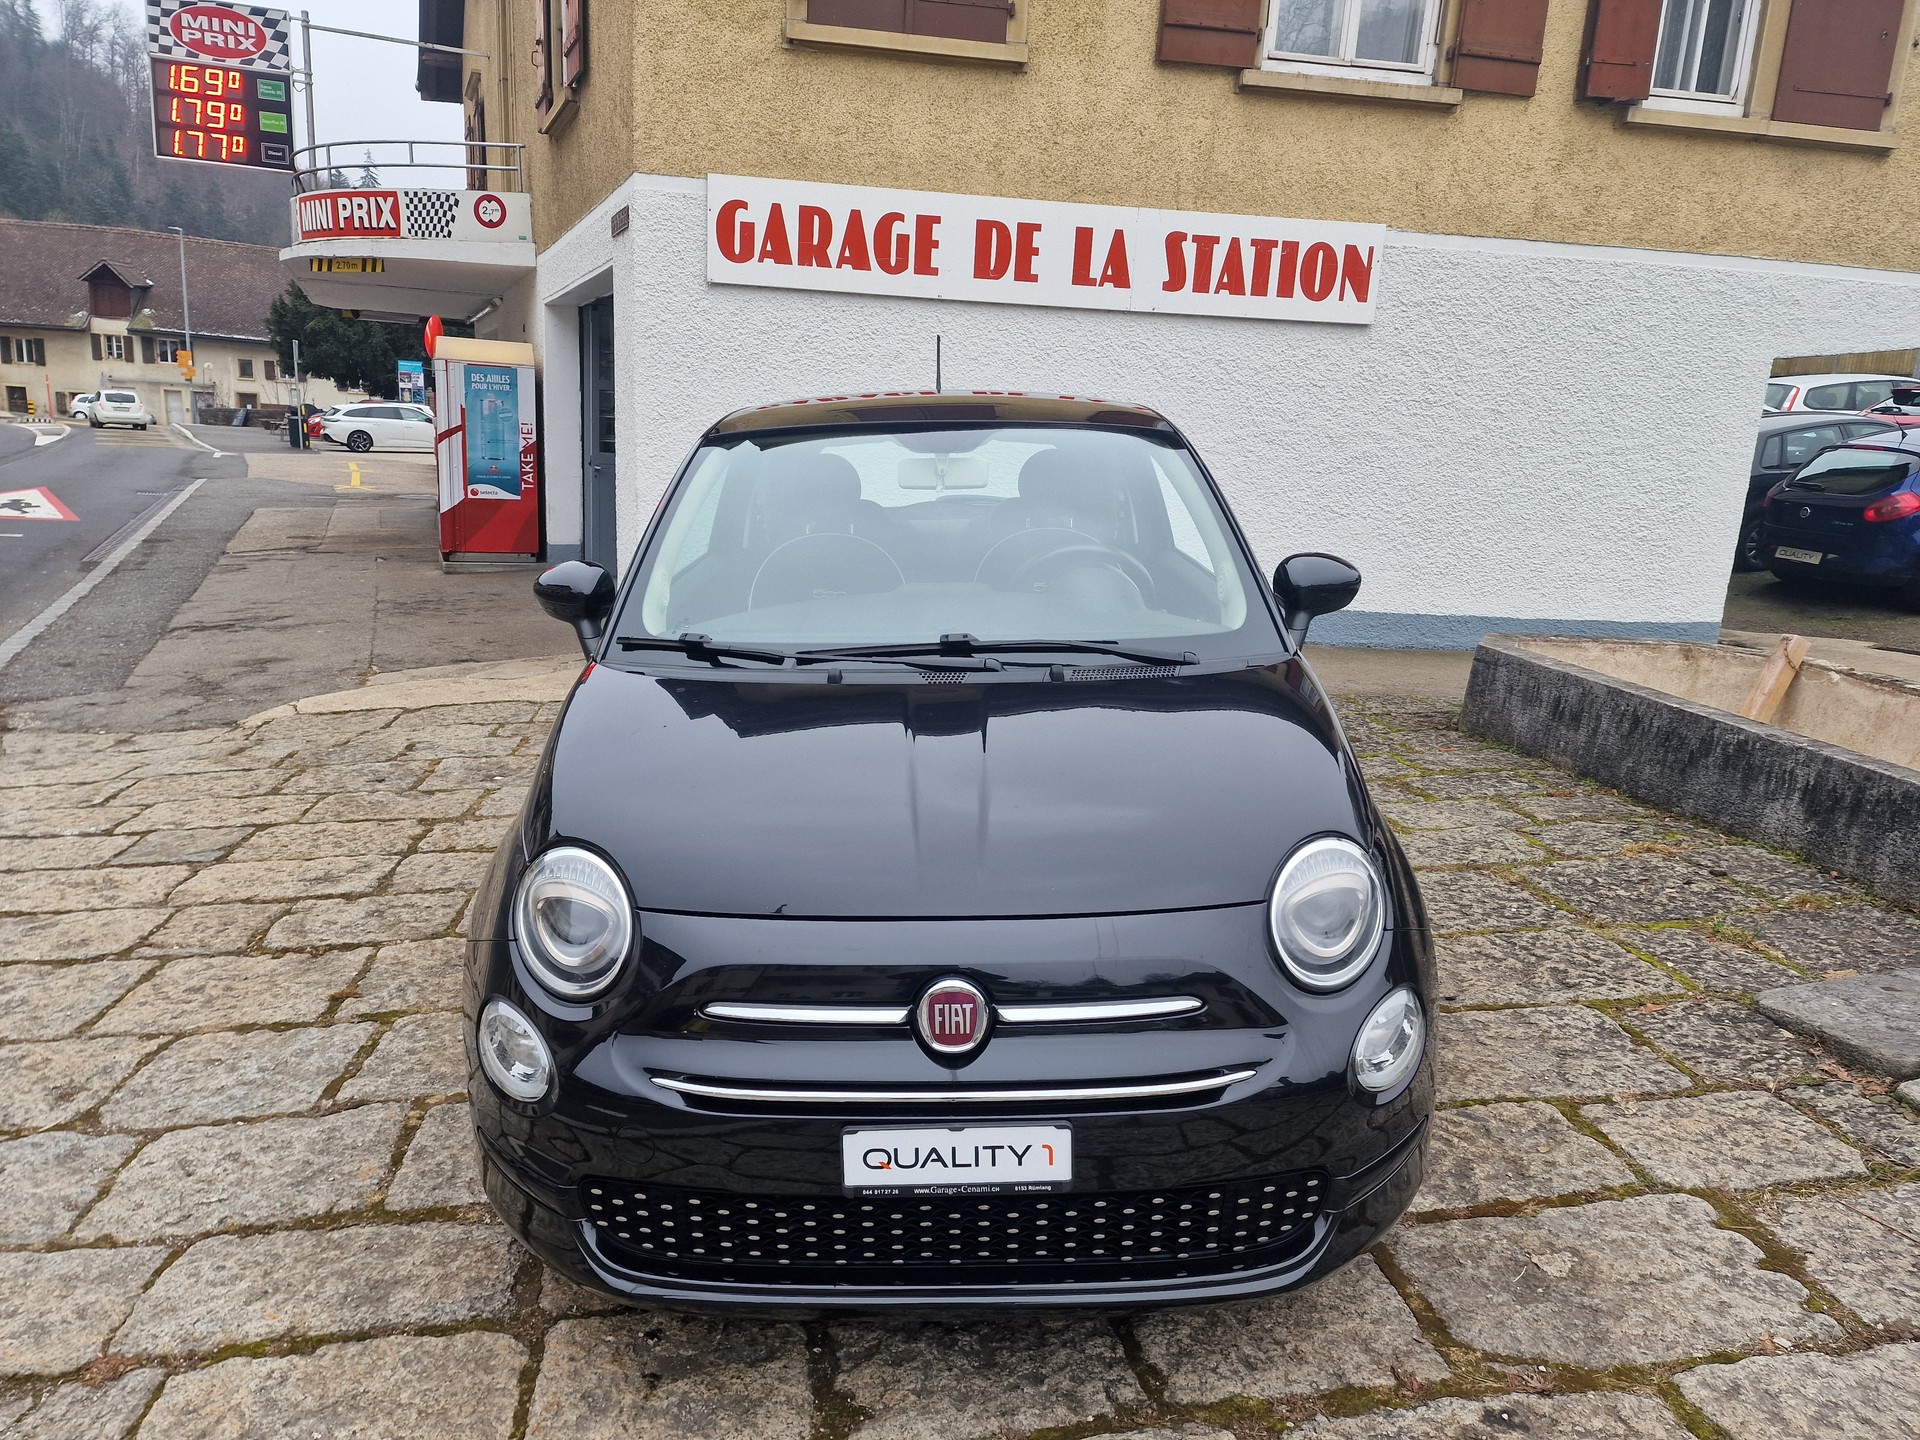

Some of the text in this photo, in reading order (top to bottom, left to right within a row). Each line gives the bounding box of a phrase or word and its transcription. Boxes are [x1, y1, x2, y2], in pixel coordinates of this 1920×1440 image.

[180, 13, 256, 36] MINI
[181, 28, 257, 52] PRIX
[301, 196, 397, 232] MINI PRIX
[715, 199, 1375, 303] GARAGE DE LA STATION
[471, 373, 485, 383] DES
[520, 422, 534, 491] TAKE ME!
[934, 1003, 974, 1035] FIAT
[862, 1144, 1054, 1170] QUALITY 1
